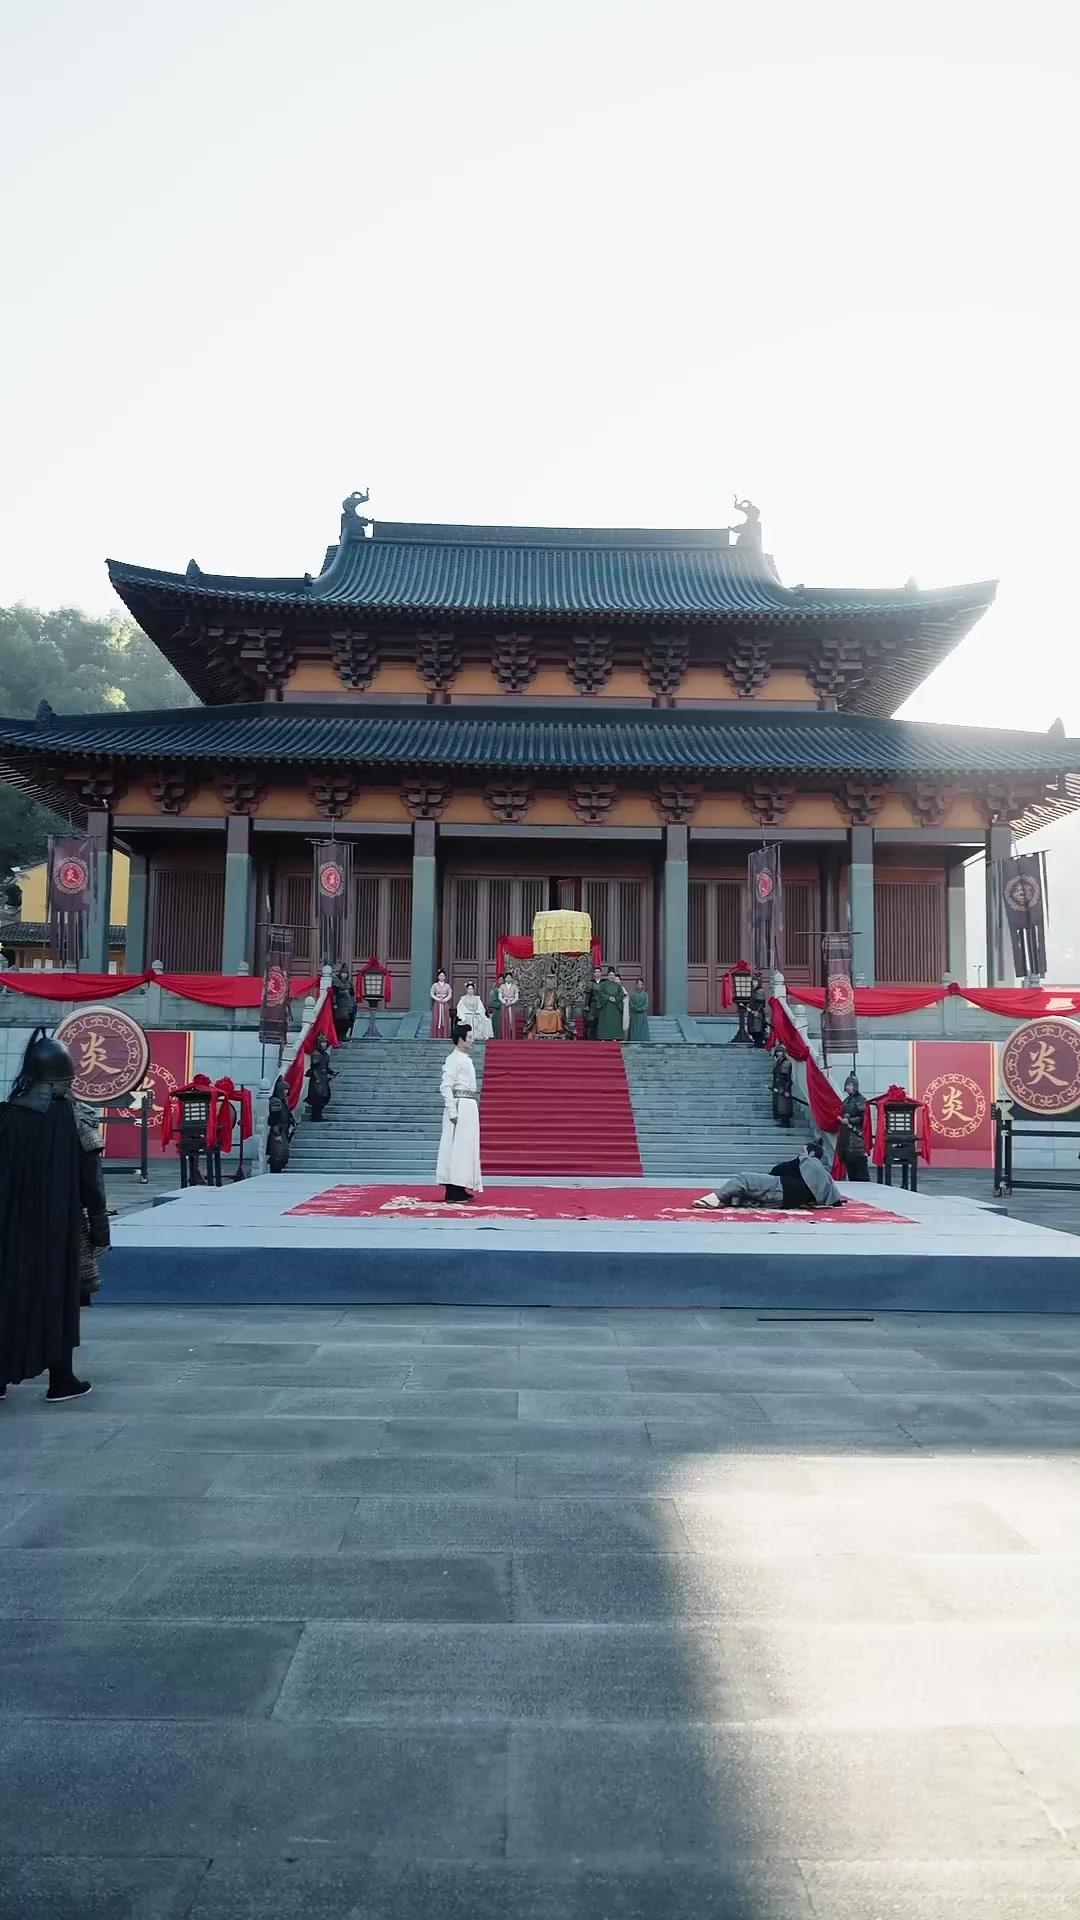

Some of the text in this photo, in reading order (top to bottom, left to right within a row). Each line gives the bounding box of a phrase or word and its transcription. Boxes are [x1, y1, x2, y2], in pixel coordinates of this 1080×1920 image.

[832, 987, 848, 1002] 炎
[80, 1031, 122, 1077] 炎
[1027, 1041, 1069, 1087] 炎
[941, 1086, 972, 1121] 炎
